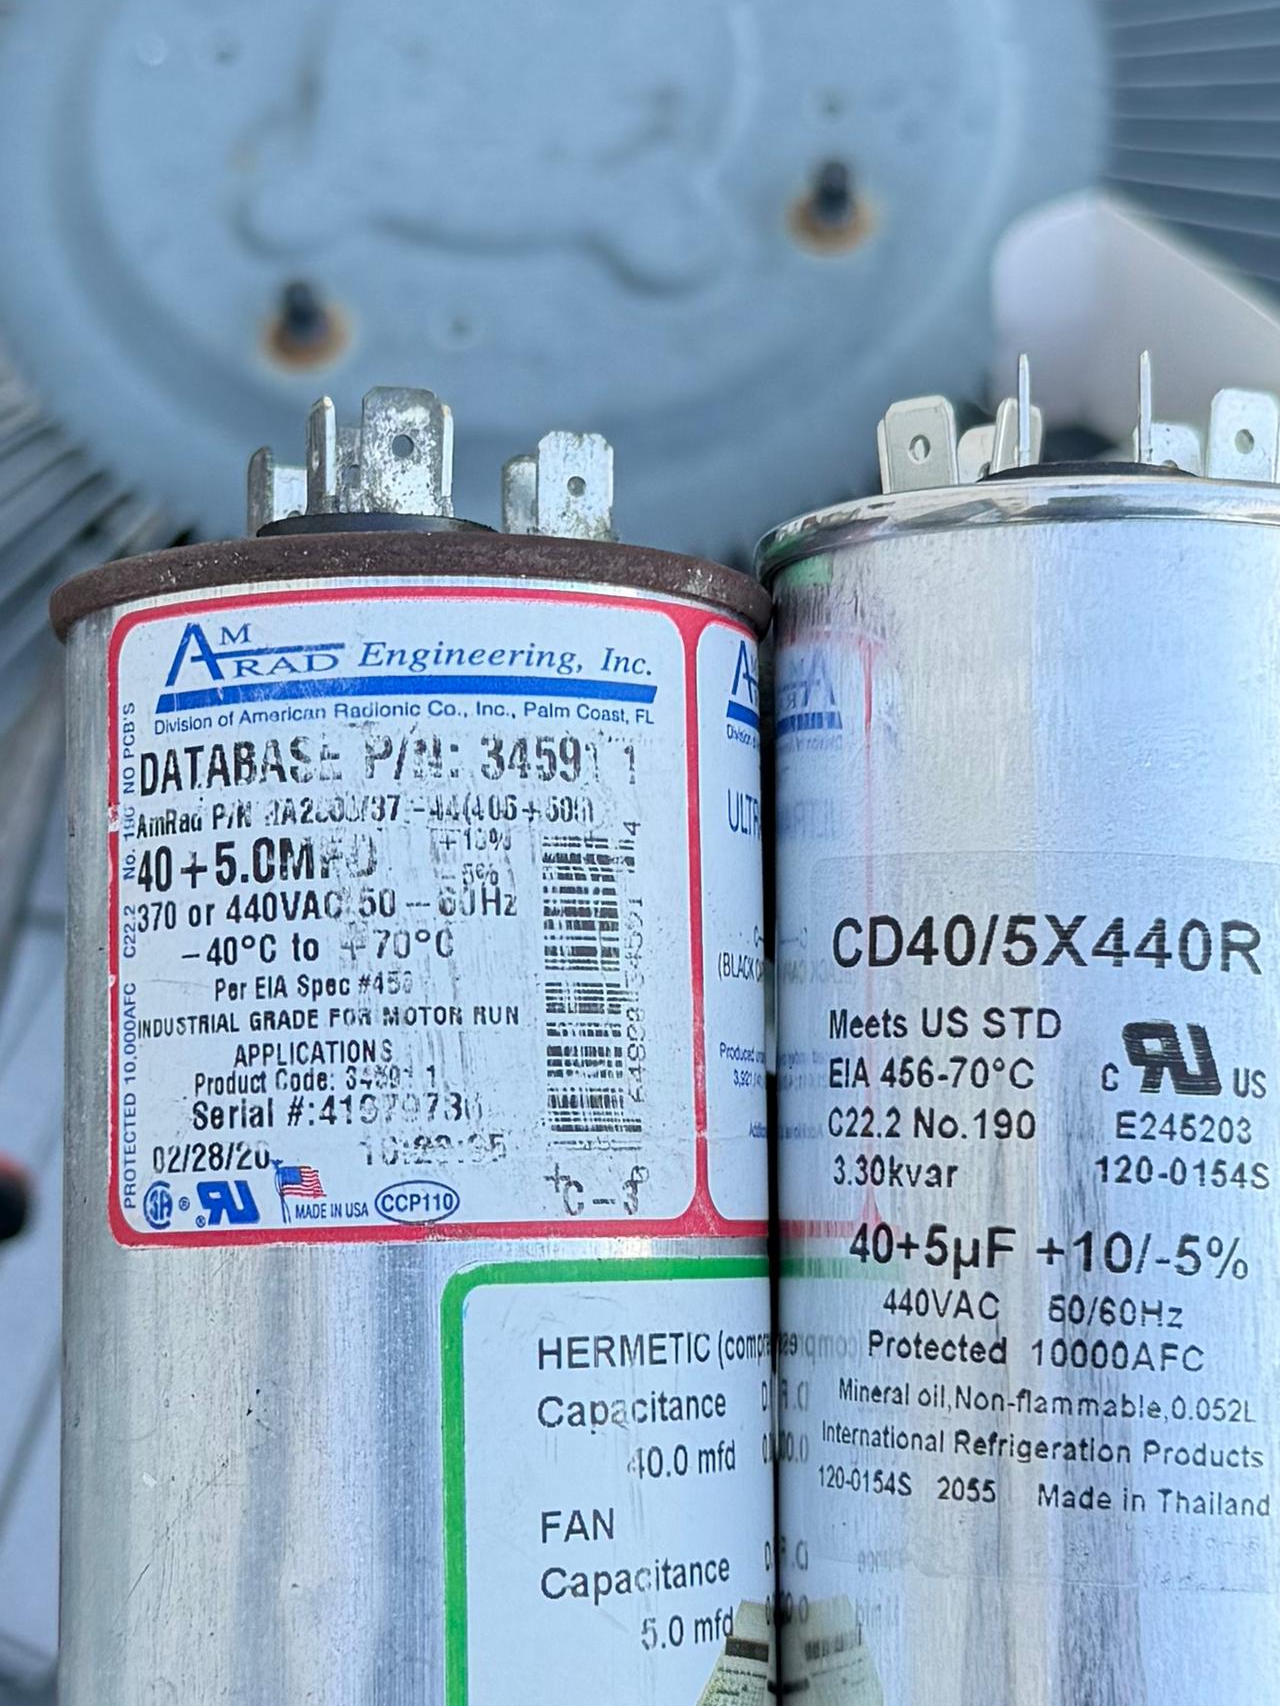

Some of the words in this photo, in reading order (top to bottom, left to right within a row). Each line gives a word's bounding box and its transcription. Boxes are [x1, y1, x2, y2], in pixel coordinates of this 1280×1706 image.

[358, 641, 583, 675] Engineering,
[600, 647, 652, 675] Inc.
[123, 701, 135, 759] PCB'S
[154, 717, 212, 735] Division
[219, 711, 233, 726] of
[239, 706, 326, 724] American
[334, 702, 420, 720] Radionic
[428, 700, 468, 718] Co.,
[476, 701, 515, 720] Inc.,
[524, 702, 570, 718] Palm
[577, 703, 629, 724] Coast,
[636, 709, 654, 725] FL
[123, 766, 135, 794] NO
[140, 734, 342, 796] DATABASE
[137, 900, 176, 933] 370
[188, 903, 215, 927] or
[226, 890, 341, 923] 440VAC
[123, 905, 136, 958] C22.2
[293, 932, 319, 962] to
[833, 914, 1262, 975] CD40/5X440R
[215, 978, 247, 1001] Per
[256, 975, 288, 1000] EIA
[297, 974, 350, 1001] Spec
[138, 1012, 240, 1039] INDUSTRIAL
[250, 1009, 319, 1031] GRADE
[329, 1006, 371, 1027] FOR
[383, 1006, 463, 1026] MOTOR
[473, 1006, 519, 1026] RUN
[829, 1008, 908, 1039] Meets
[921, 1005, 968, 1038] US
[982, 1006, 1062, 1039] STD
[234, 1039, 393, 1068] APPLICATIONS
[195, 1070, 267, 1097] Product
[275, 1068, 335, 1091] Code:
[829, 1056, 870, 1088] EIA
[880, 1055, 1034, 1089] 456-70°C
[192, 1097, 273, 1130] Serial
[828, 1106, 901, 1138] C22.2
[914, 1106, 1036, 1139] No.190
[124, 1093, 136, 1208] PROTECTED
[834, 1154, 958, 1187] 3.30kvar
[1095, 1154, 1270, 1189] 120-0154S
[295, 1203, 327, 1220] MADE
[330, 1203, 342, 1218] IN
[345, 1202, 368, 1218] USA
[381, 1192, 454, 1213] CCP110
[1036, 1230, 1248, 1280] +10/-5%
[883, 1287, 1000, 1320] 440VAC
[1048, 1294, 1183, 1329] 50/60Hz
[538, 1332, 710, 1370] HERMETIC
[868, 1329, 1007, 1364] Protected
[1031, 1338, 1205, 1372] 10000AFC
[839, 1377, 909, 1407] Mineral
[538, 1391, 726, 1434] Capacitance
[698, 1440, 736, 1474] mfd
[822, 1420, 944, 1453] International
[955, 1429, 1130, 1463] Refrigeration
[1143, 1439, 1264, 1468] Products
[818, 1464, 912, 1496] 120-0154S
[937, 1476, 996, 1503] 2055
[1038, 1483, 1112, 1511] Made
[1123, 1488, 1145, 1512] in
[1157, 1488, 1270, 1517] Thailand
[541, 1507, 614, 1543] FAN
[541, 1557, 730, 1605] Capacitance
[641, 1615, 684, 1650] 5.0
[694, 1606, 734, 1645] mfd
